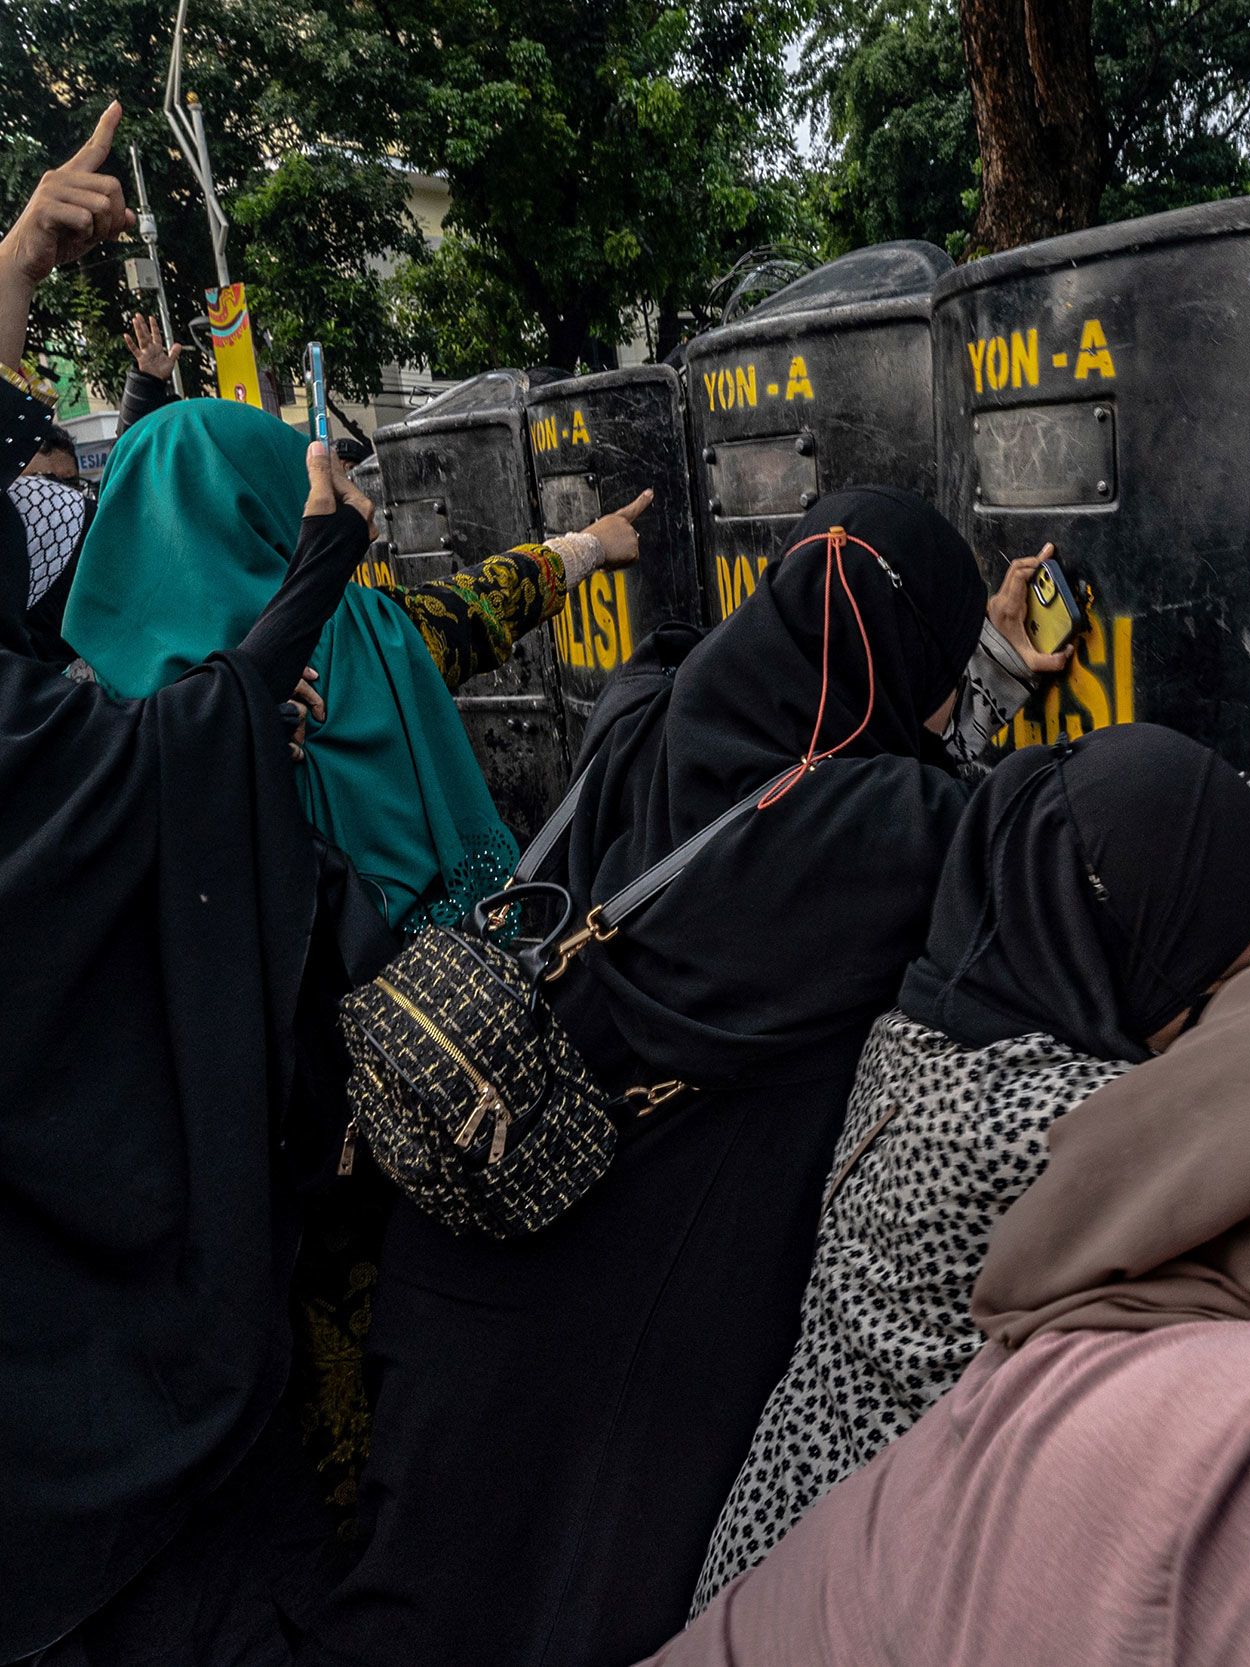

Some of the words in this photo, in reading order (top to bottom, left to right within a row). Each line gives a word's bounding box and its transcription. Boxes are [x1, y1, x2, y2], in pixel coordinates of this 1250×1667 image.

[704, 365, 757, 411] YON
[786, 356, 814, 400] A
[967, 328, 1039, 393] YON
[1074, 319, 1116, 379] A
[531, 416, 558, 453] YON
[572, 410, 590, 444] A
[553, 569, 634, 670] OLISI
